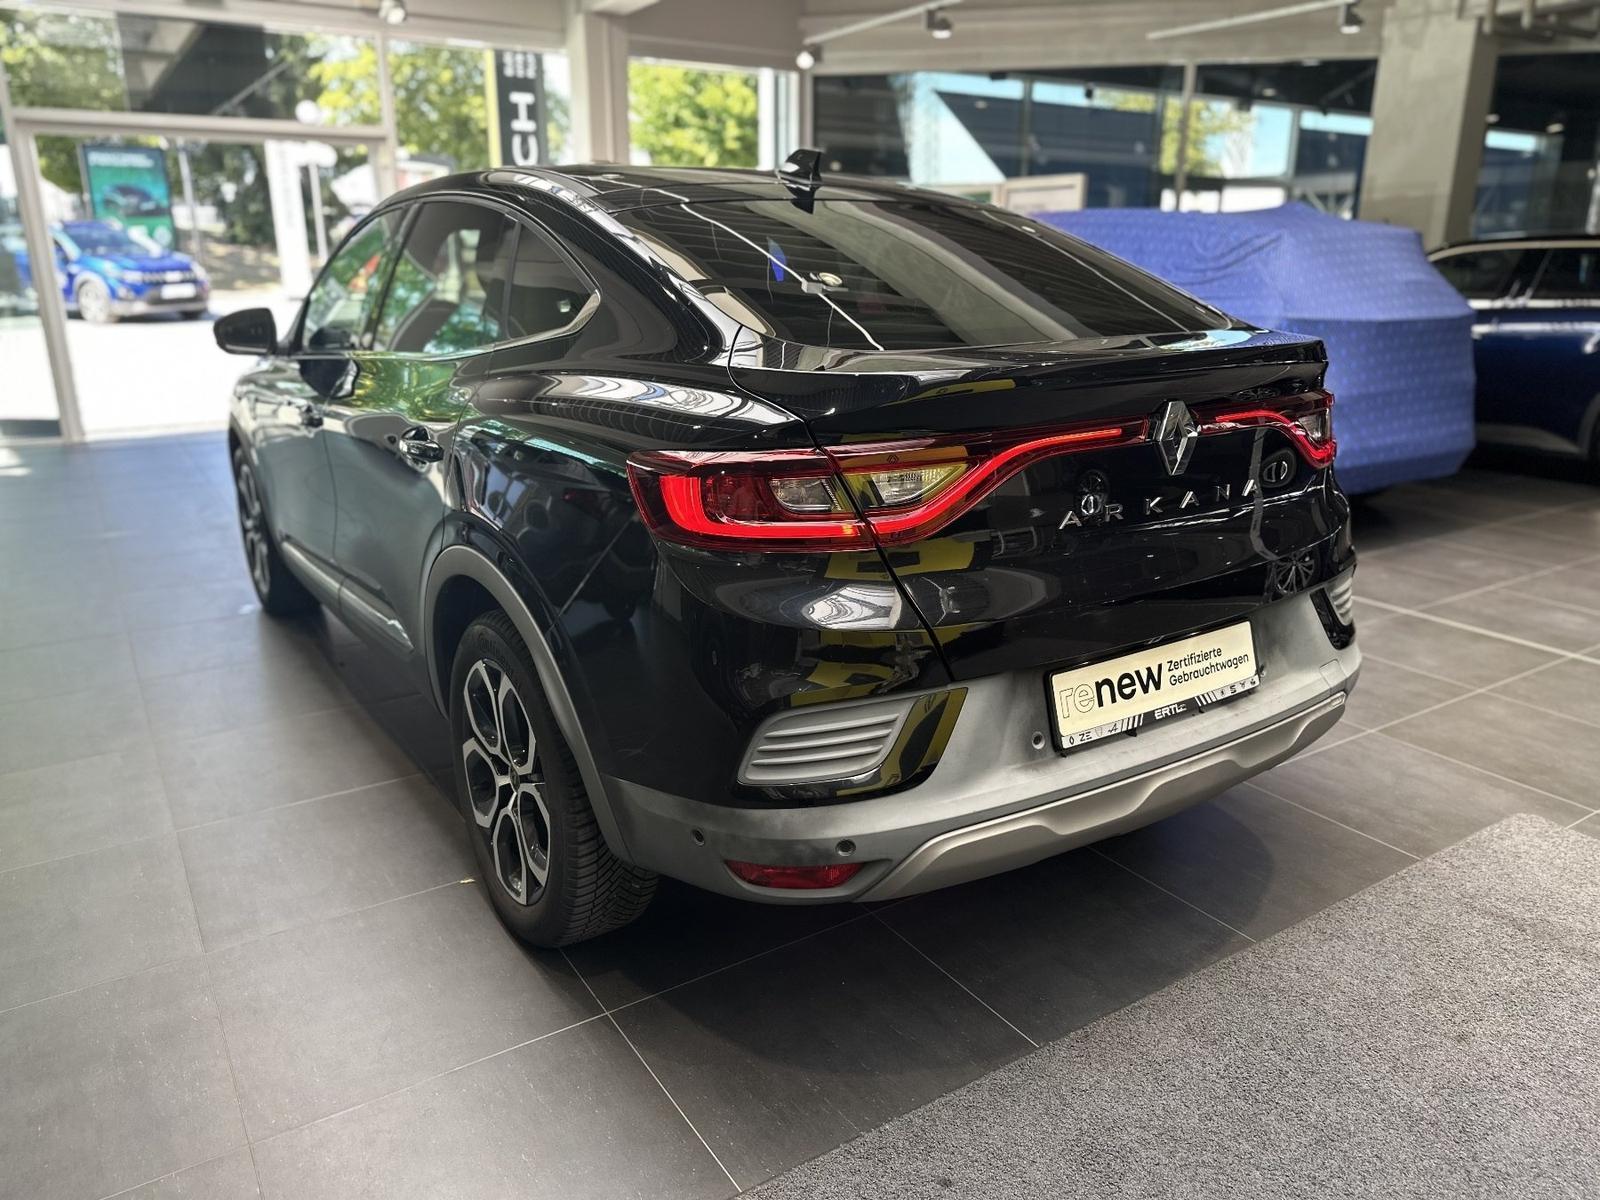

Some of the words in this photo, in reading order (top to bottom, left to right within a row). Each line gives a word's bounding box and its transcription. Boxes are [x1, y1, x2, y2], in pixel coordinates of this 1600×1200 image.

[1058, 478, 1259, 530] ARKANA
[1167, 646, 1222, 672] Zertifizierte
[1169, 653, 1249, 686] Gebrauchtwagen
[1059, 663, 1163, 719] renew
